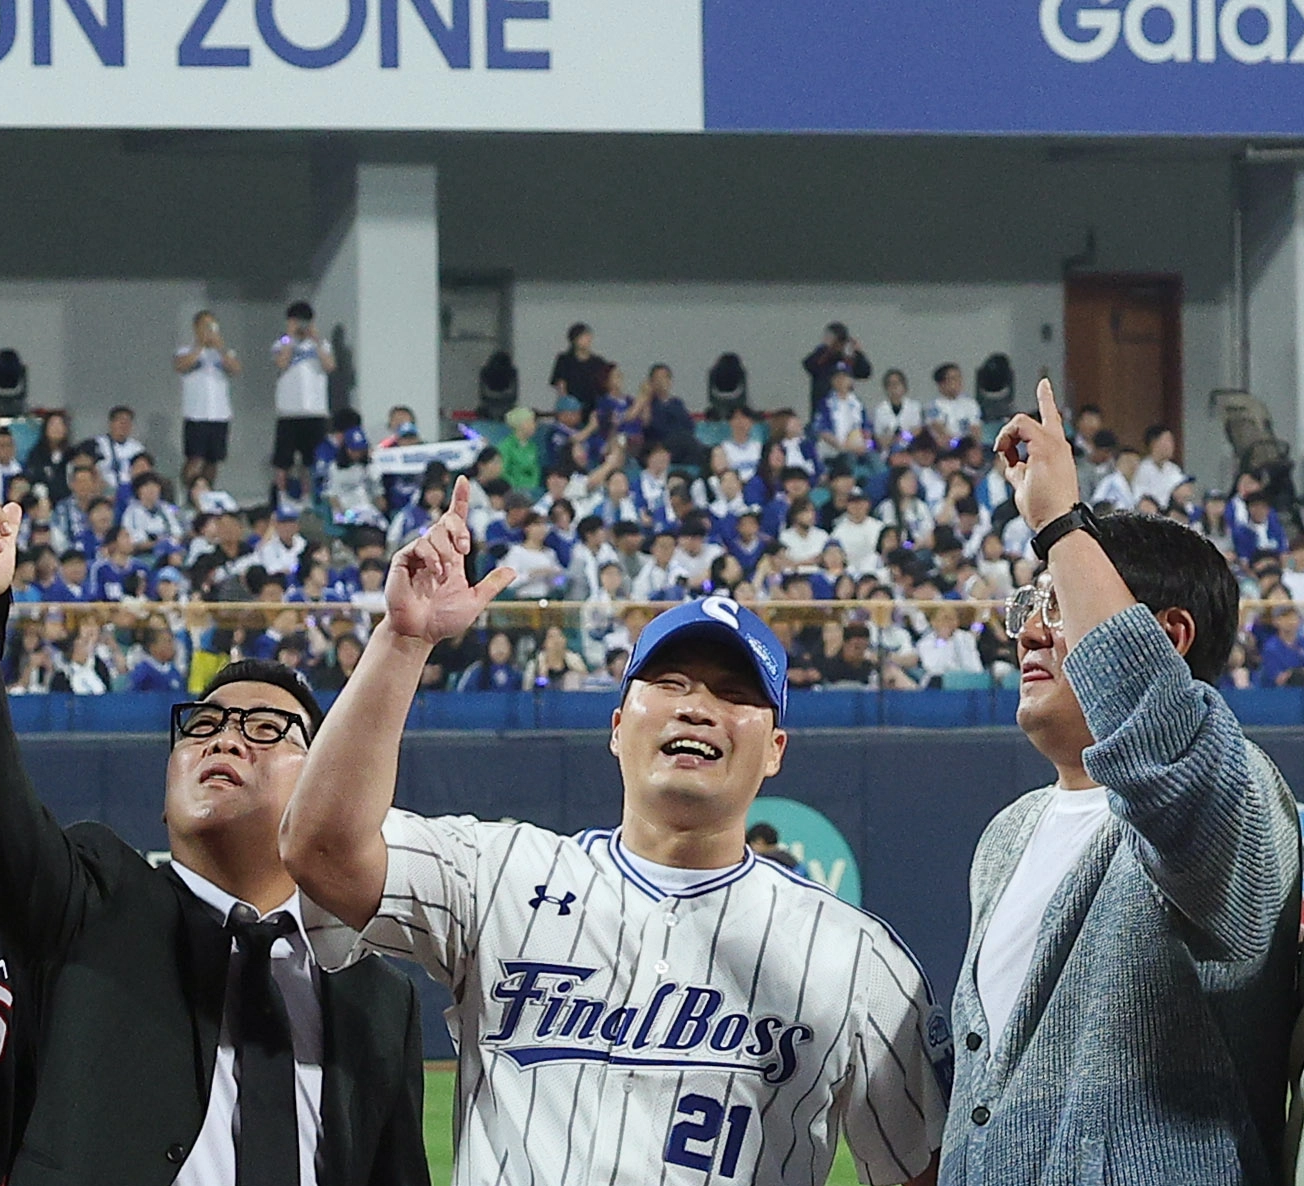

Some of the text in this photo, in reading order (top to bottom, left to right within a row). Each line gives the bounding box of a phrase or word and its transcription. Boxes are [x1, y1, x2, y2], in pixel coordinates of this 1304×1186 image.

[484, 960, 677, 1052] Final
[658, 985, 814, 1086] Boss
[663, 1092, 754, 1179] 21
